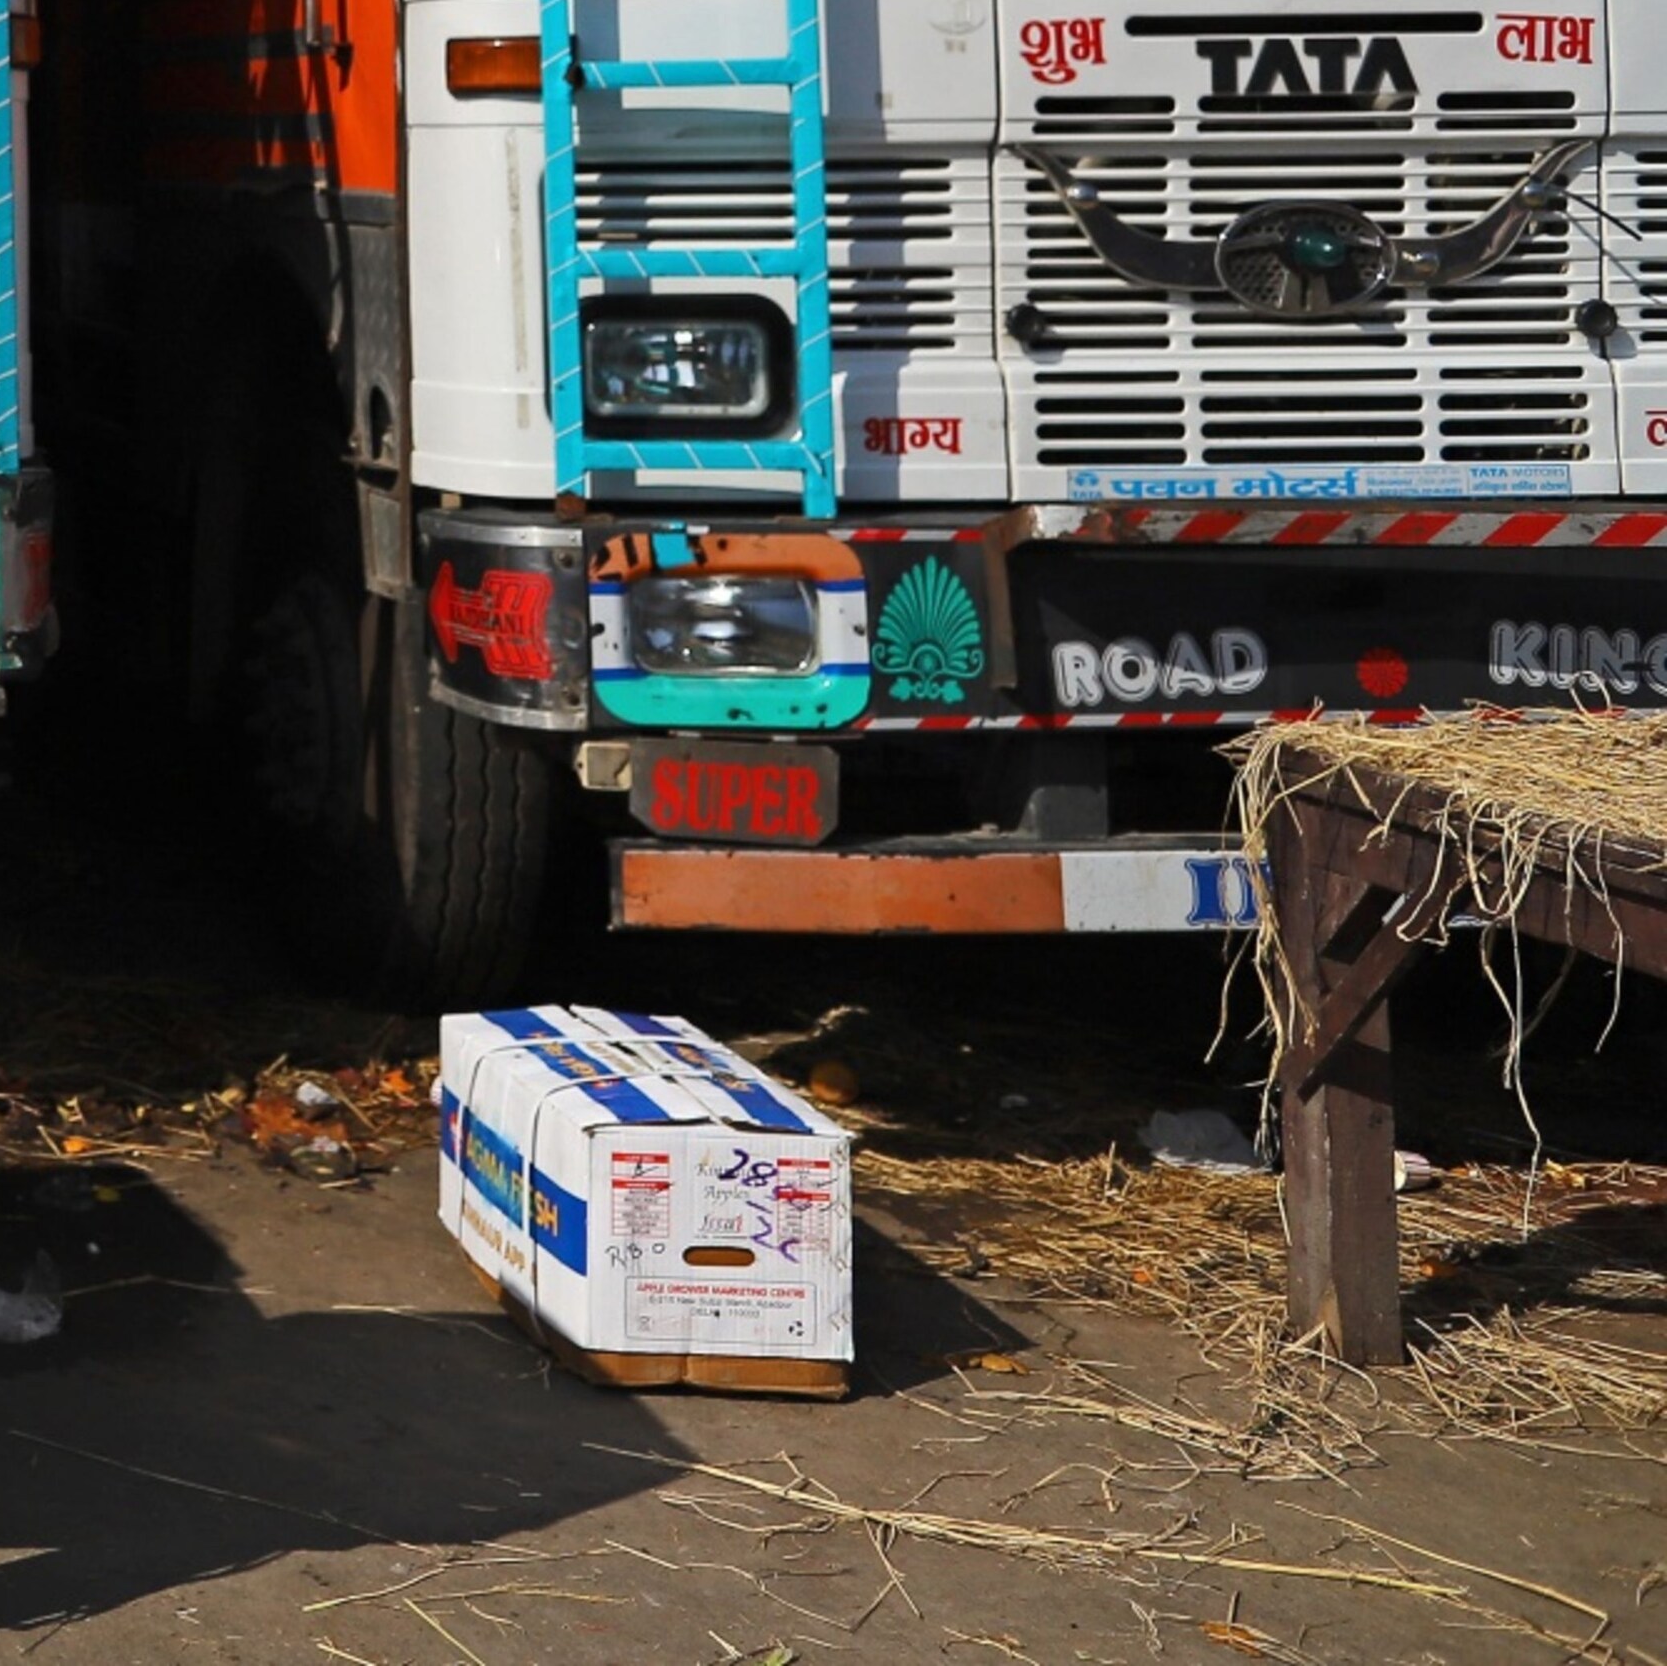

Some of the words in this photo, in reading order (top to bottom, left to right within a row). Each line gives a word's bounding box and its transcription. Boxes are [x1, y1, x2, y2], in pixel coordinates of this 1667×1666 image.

[1019, 17, 1107, 85] शुभ
[1495, 12, 1595, 65] लाभ
[1195, 37, 1421, 97] TATA
[862, 414, 963, 458] भाग्य
[1111, 478, 1217, 499] पवन
[1232, 467, 1360, 499] मोटर्स
[1470, 467, 1508, 478] TATA
[1512, 467, 1566, 478] MOTORS
[1051, 628, 1268, 707] ROAD
[649, 755, 823, 838] SUPER
[712, 1286, 768, 1298] MARKETING
